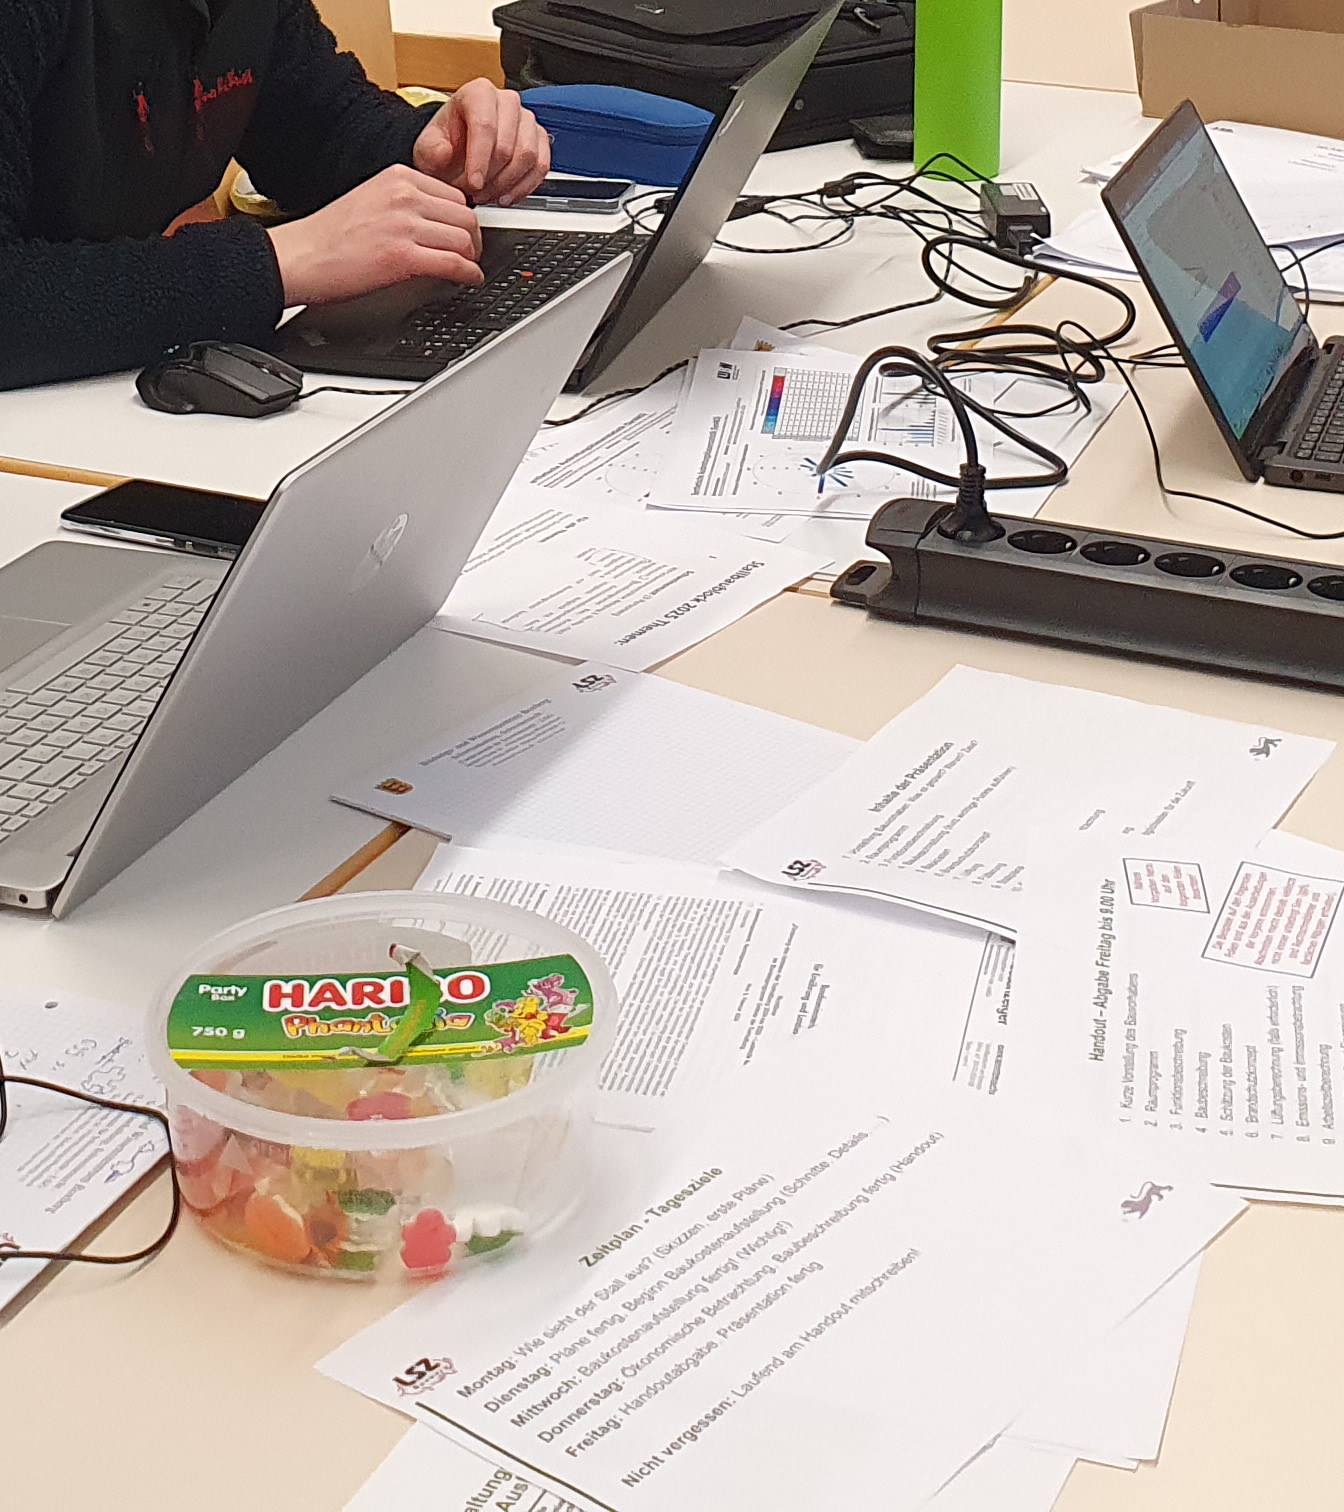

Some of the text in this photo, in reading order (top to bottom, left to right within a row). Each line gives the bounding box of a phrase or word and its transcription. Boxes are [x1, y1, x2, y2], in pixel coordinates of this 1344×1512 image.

[191, 1026, 246, 1039] 750 g
[198, 984, 247, 998] Party
[265, 972, 488, 1011] HARIO
[1088, 879, 1116, 1061] Handout Abgabe Freitag bis 9.00 Uhr
[456, 1357, 518, 1398] Montag:
[513, 1338, 545, 1357] Wie
[543, 1315, 577, 1339] sieht
[574, 1299, 597, 1317] der
[594, 1279, 626, 1301] Stall
[625, 1256, 654, 1281] aus?
[706, 1201, 737, 1221] erste
[732, 1174, 775, 1201] Pläne)
[483, 1364, 553, 1413] Dienstag:
[549, 1337, 591, 1365] Pläne
[621, 1280, 669, 1311] Beginn
[664, 1197, 786, 1280] Baukostenaufstellung
[537, 1378, 625, 1443] Donnerstag:
[620, 1316, 706, 1378] Ökonomische
[771, 1190, 870, 1268] Baubeschreibung
[862, 1173, 896, 1201] fertig
[889, 1132, 944, 1178] (Handout)
[578, 1225, 643, 1267] Zeitplan
[645, 1168, 722, 1217] Tagesziele
[510, 1376, 582, 1427] Mittwoch:
[577, 1278, 709, 1377] Baukostenaufstellung
[701, 1258, 740, 1284] fertig!
[565, 1415, 623, 1457] Freitag:
[716, 1284, 793, 1339] Präsentation
[787, 1262, 824, 1288] fertig
[621, 1456, 665, 1487] Nicht
[661, 1391, 736, 1455] vergessen:
[731, 1356, 785, 1398] Laufend
[781, 1337, 805, 1359] am
[799, 1303, 854, 1342] Handout
